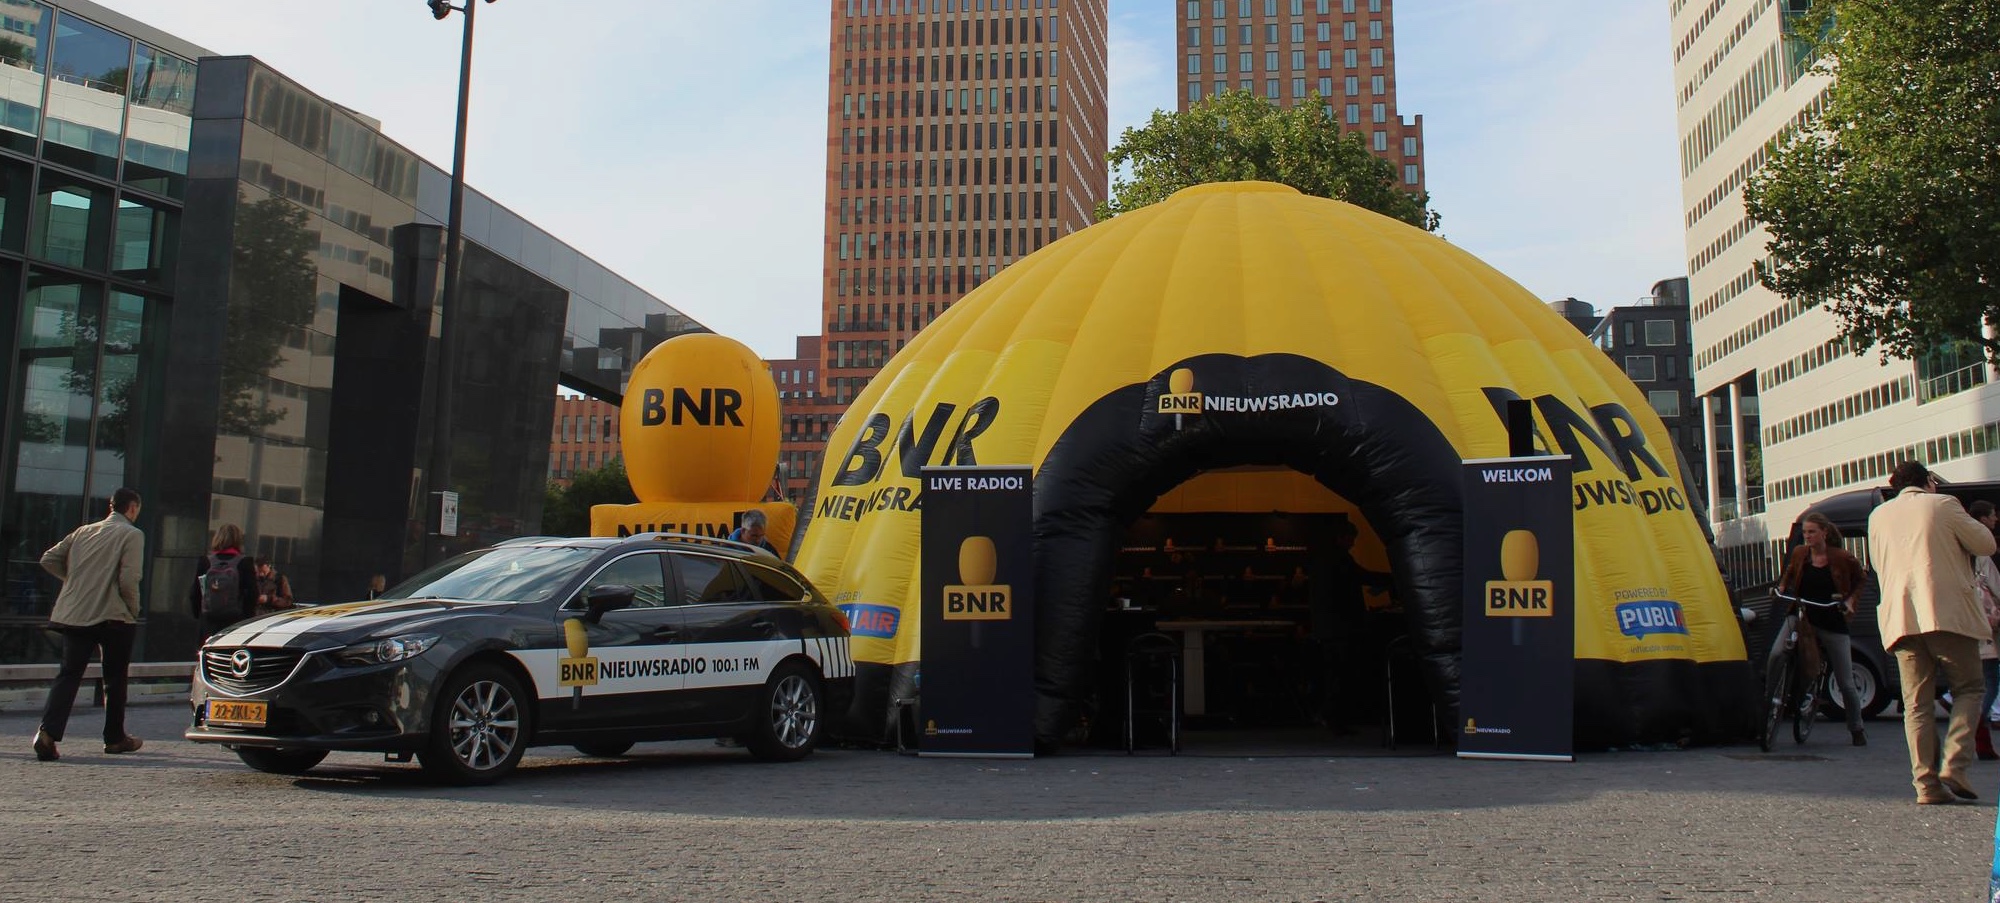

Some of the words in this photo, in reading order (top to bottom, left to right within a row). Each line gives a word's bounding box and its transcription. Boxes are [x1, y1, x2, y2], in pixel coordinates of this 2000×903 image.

[641, 387, 745, 427] BNR
[1161, 396, 1199, 410] BNR
[1205, 392, 1339, 413] NIEUWSRADIO
[831, 396, 1000, 487] BNR
[930, 477, 962, 490] LIVE
[967, 477, 1023, 490] RADIO!
[1482, 468, 1552, 483] WELKOM
[817, 486, 922, 522] NIEUWSRA
[618, 523, 731, 544] NIEUW
[948, 592, 1006, 613] BNR
[1490, 587, 1547, 609] BNR
[1614, 588, 1658, 600] POWERED
[1620, 606, 1684, 629] PUBLI
[561, 662, 595, 681] BNR
[600, 657, 707, 679] NIEUWSRADIO
[712, 658, 739, 673] 100.1
[743, 657, 760, 671] FM
